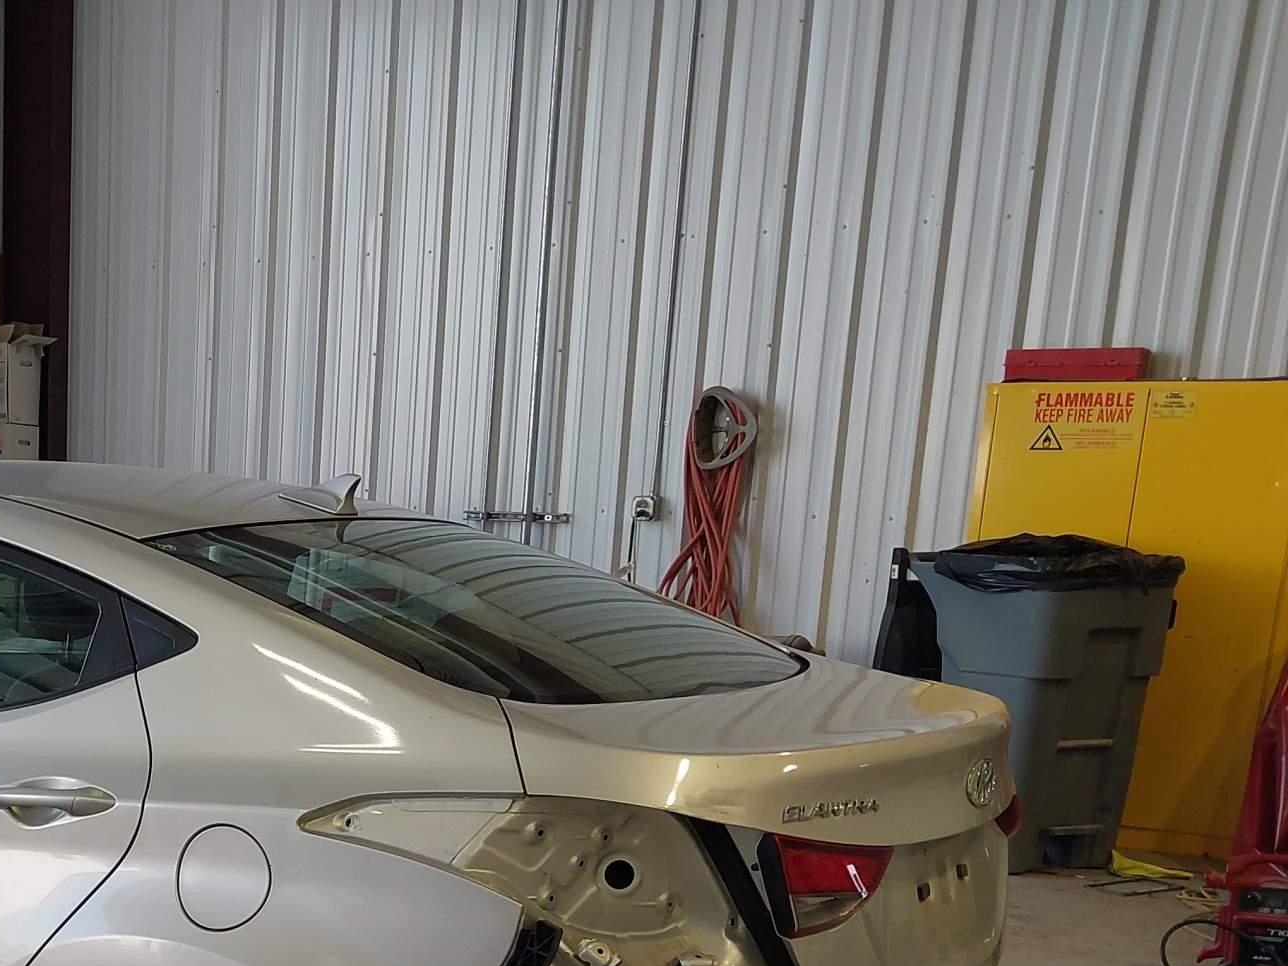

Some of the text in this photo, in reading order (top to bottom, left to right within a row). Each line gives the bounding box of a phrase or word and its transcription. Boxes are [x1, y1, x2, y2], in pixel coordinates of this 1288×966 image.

[1035, 392, 1135, 407] FLAMMABLE
[1034, 408, 1133, 423] KEEP FIRE AWAY
[782, 797, 880, 824] ELANTRA
